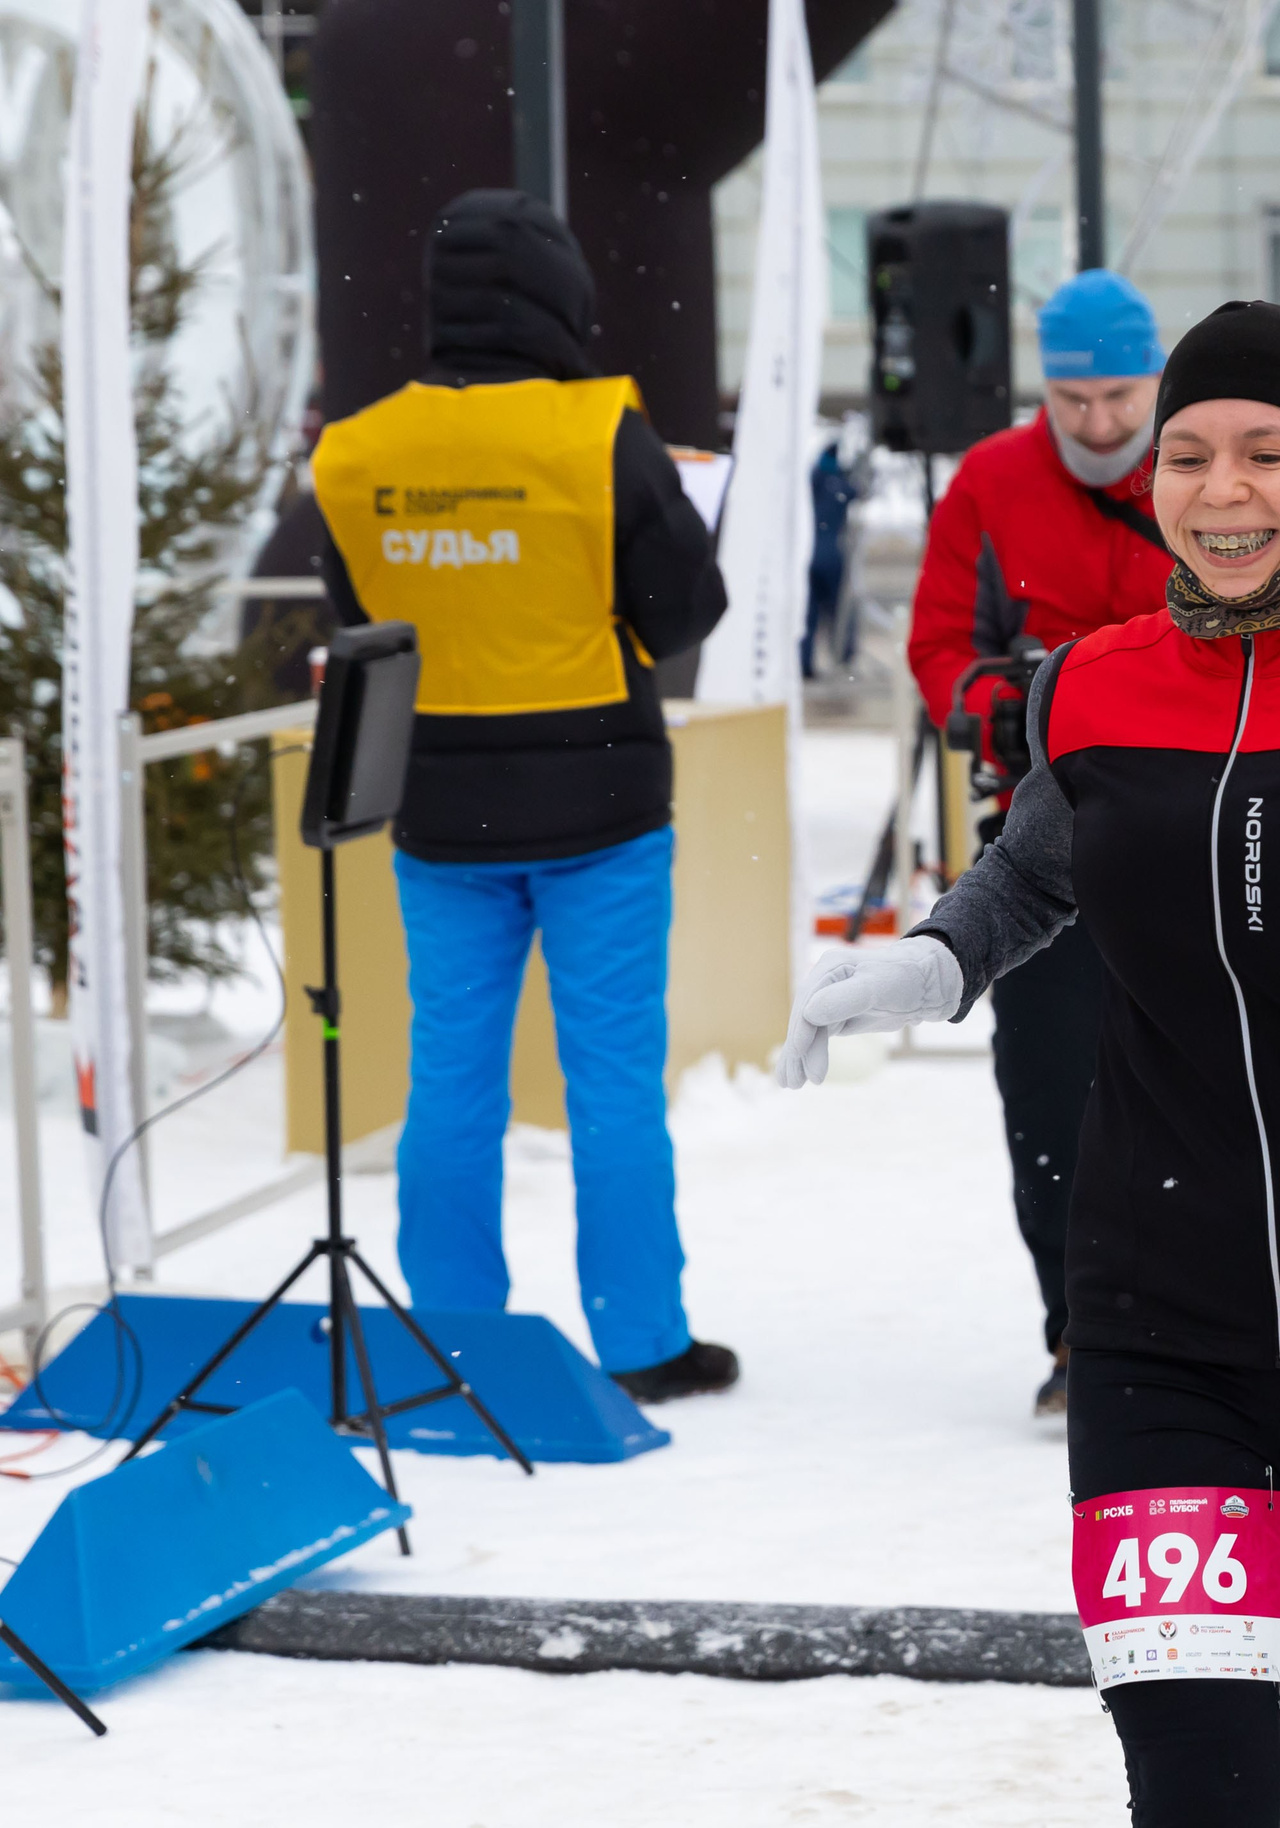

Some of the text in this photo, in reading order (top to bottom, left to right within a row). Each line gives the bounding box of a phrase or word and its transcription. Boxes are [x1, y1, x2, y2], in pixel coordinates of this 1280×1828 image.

[381, 528, 520, 570] СУДЬЯ
[1245, 797, 1264, 932] NORDSKI
[1169, 1497, 1208, 1505] ПЕЛЬМЕННЫЙ
[1169, 1504, 1200, 1513] КУБОК
[1103, 1504, 1134, 1519] РСХБ
[1102, 1531, 1248, 1608] 496
[1111, 1627, 1146, 1636] КАЛАШНИКОВ
